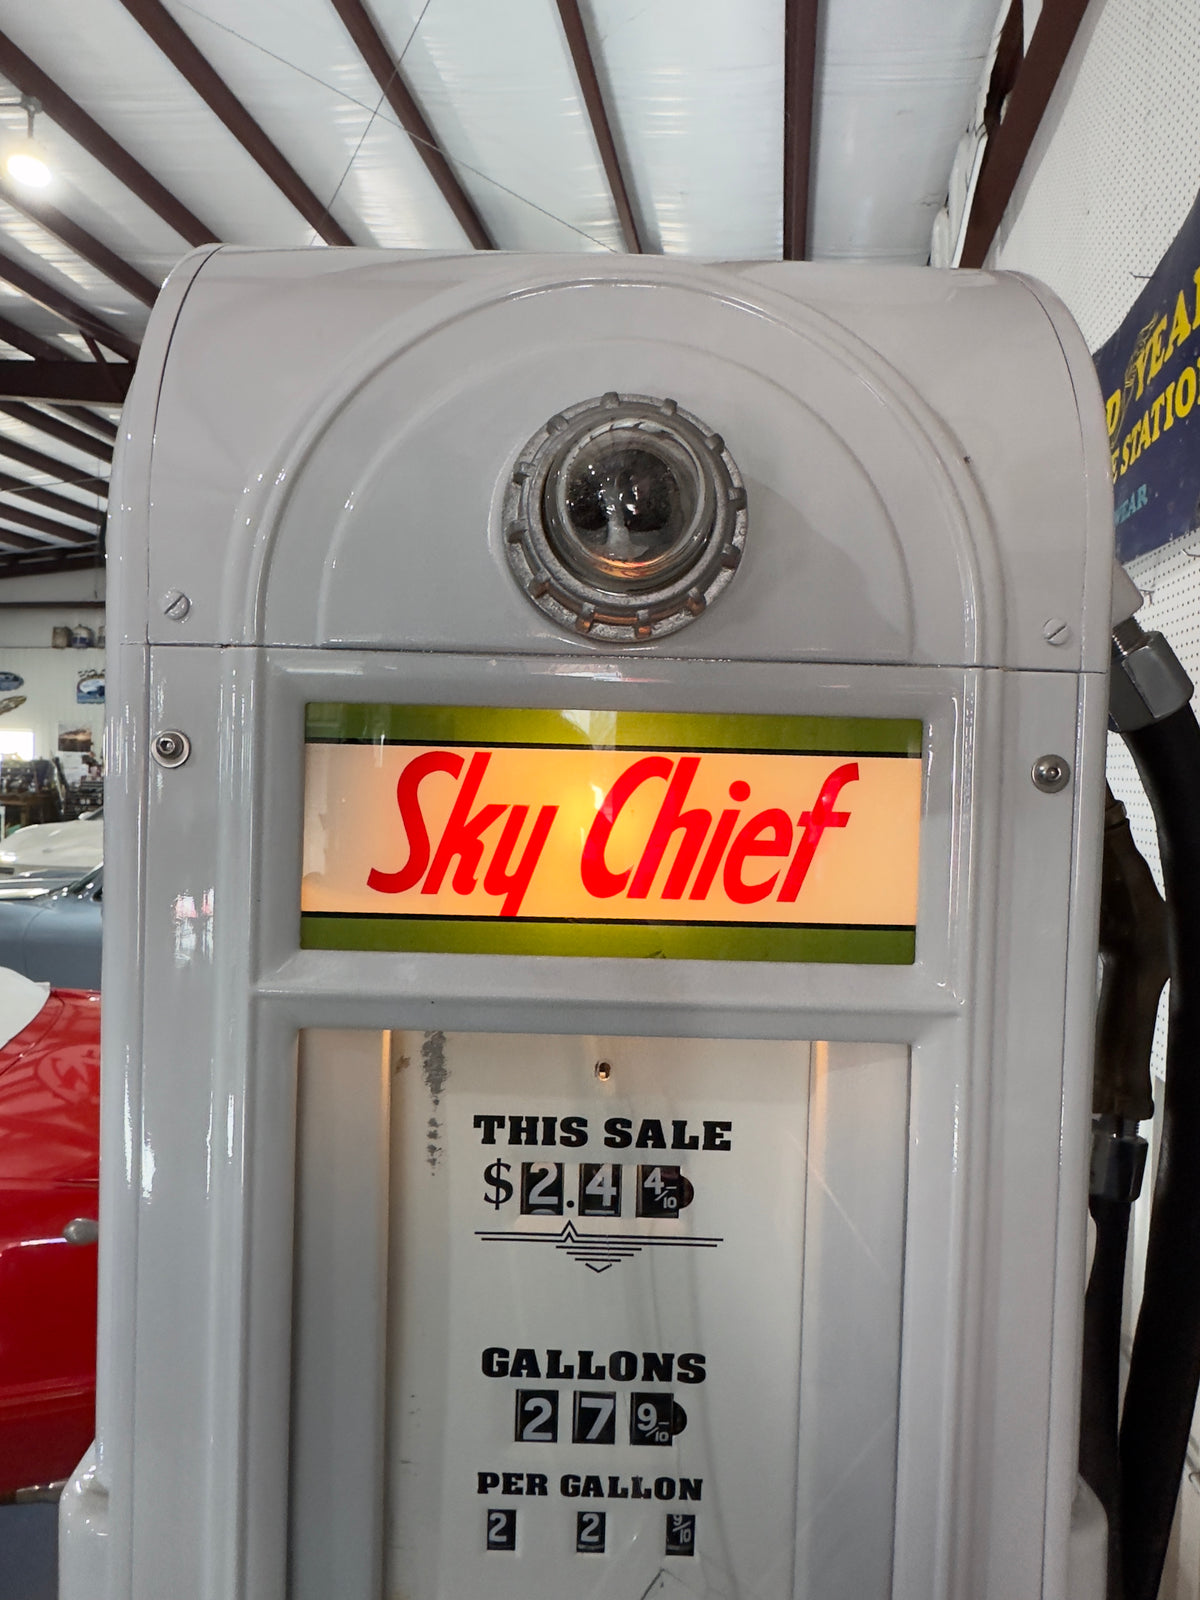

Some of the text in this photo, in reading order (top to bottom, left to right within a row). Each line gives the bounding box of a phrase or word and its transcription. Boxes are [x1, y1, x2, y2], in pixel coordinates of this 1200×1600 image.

[367, 751, 860, 916] Sky Chief
[473, 1115, 732, 1151] THIS SALE
[481, 1347, 706, 1384] GALLONS
[477, 1472, 703, 1500] PER GALLON
[489, 1512, 507, 1542] 2
[580, 1513, 600, 1542] 2
